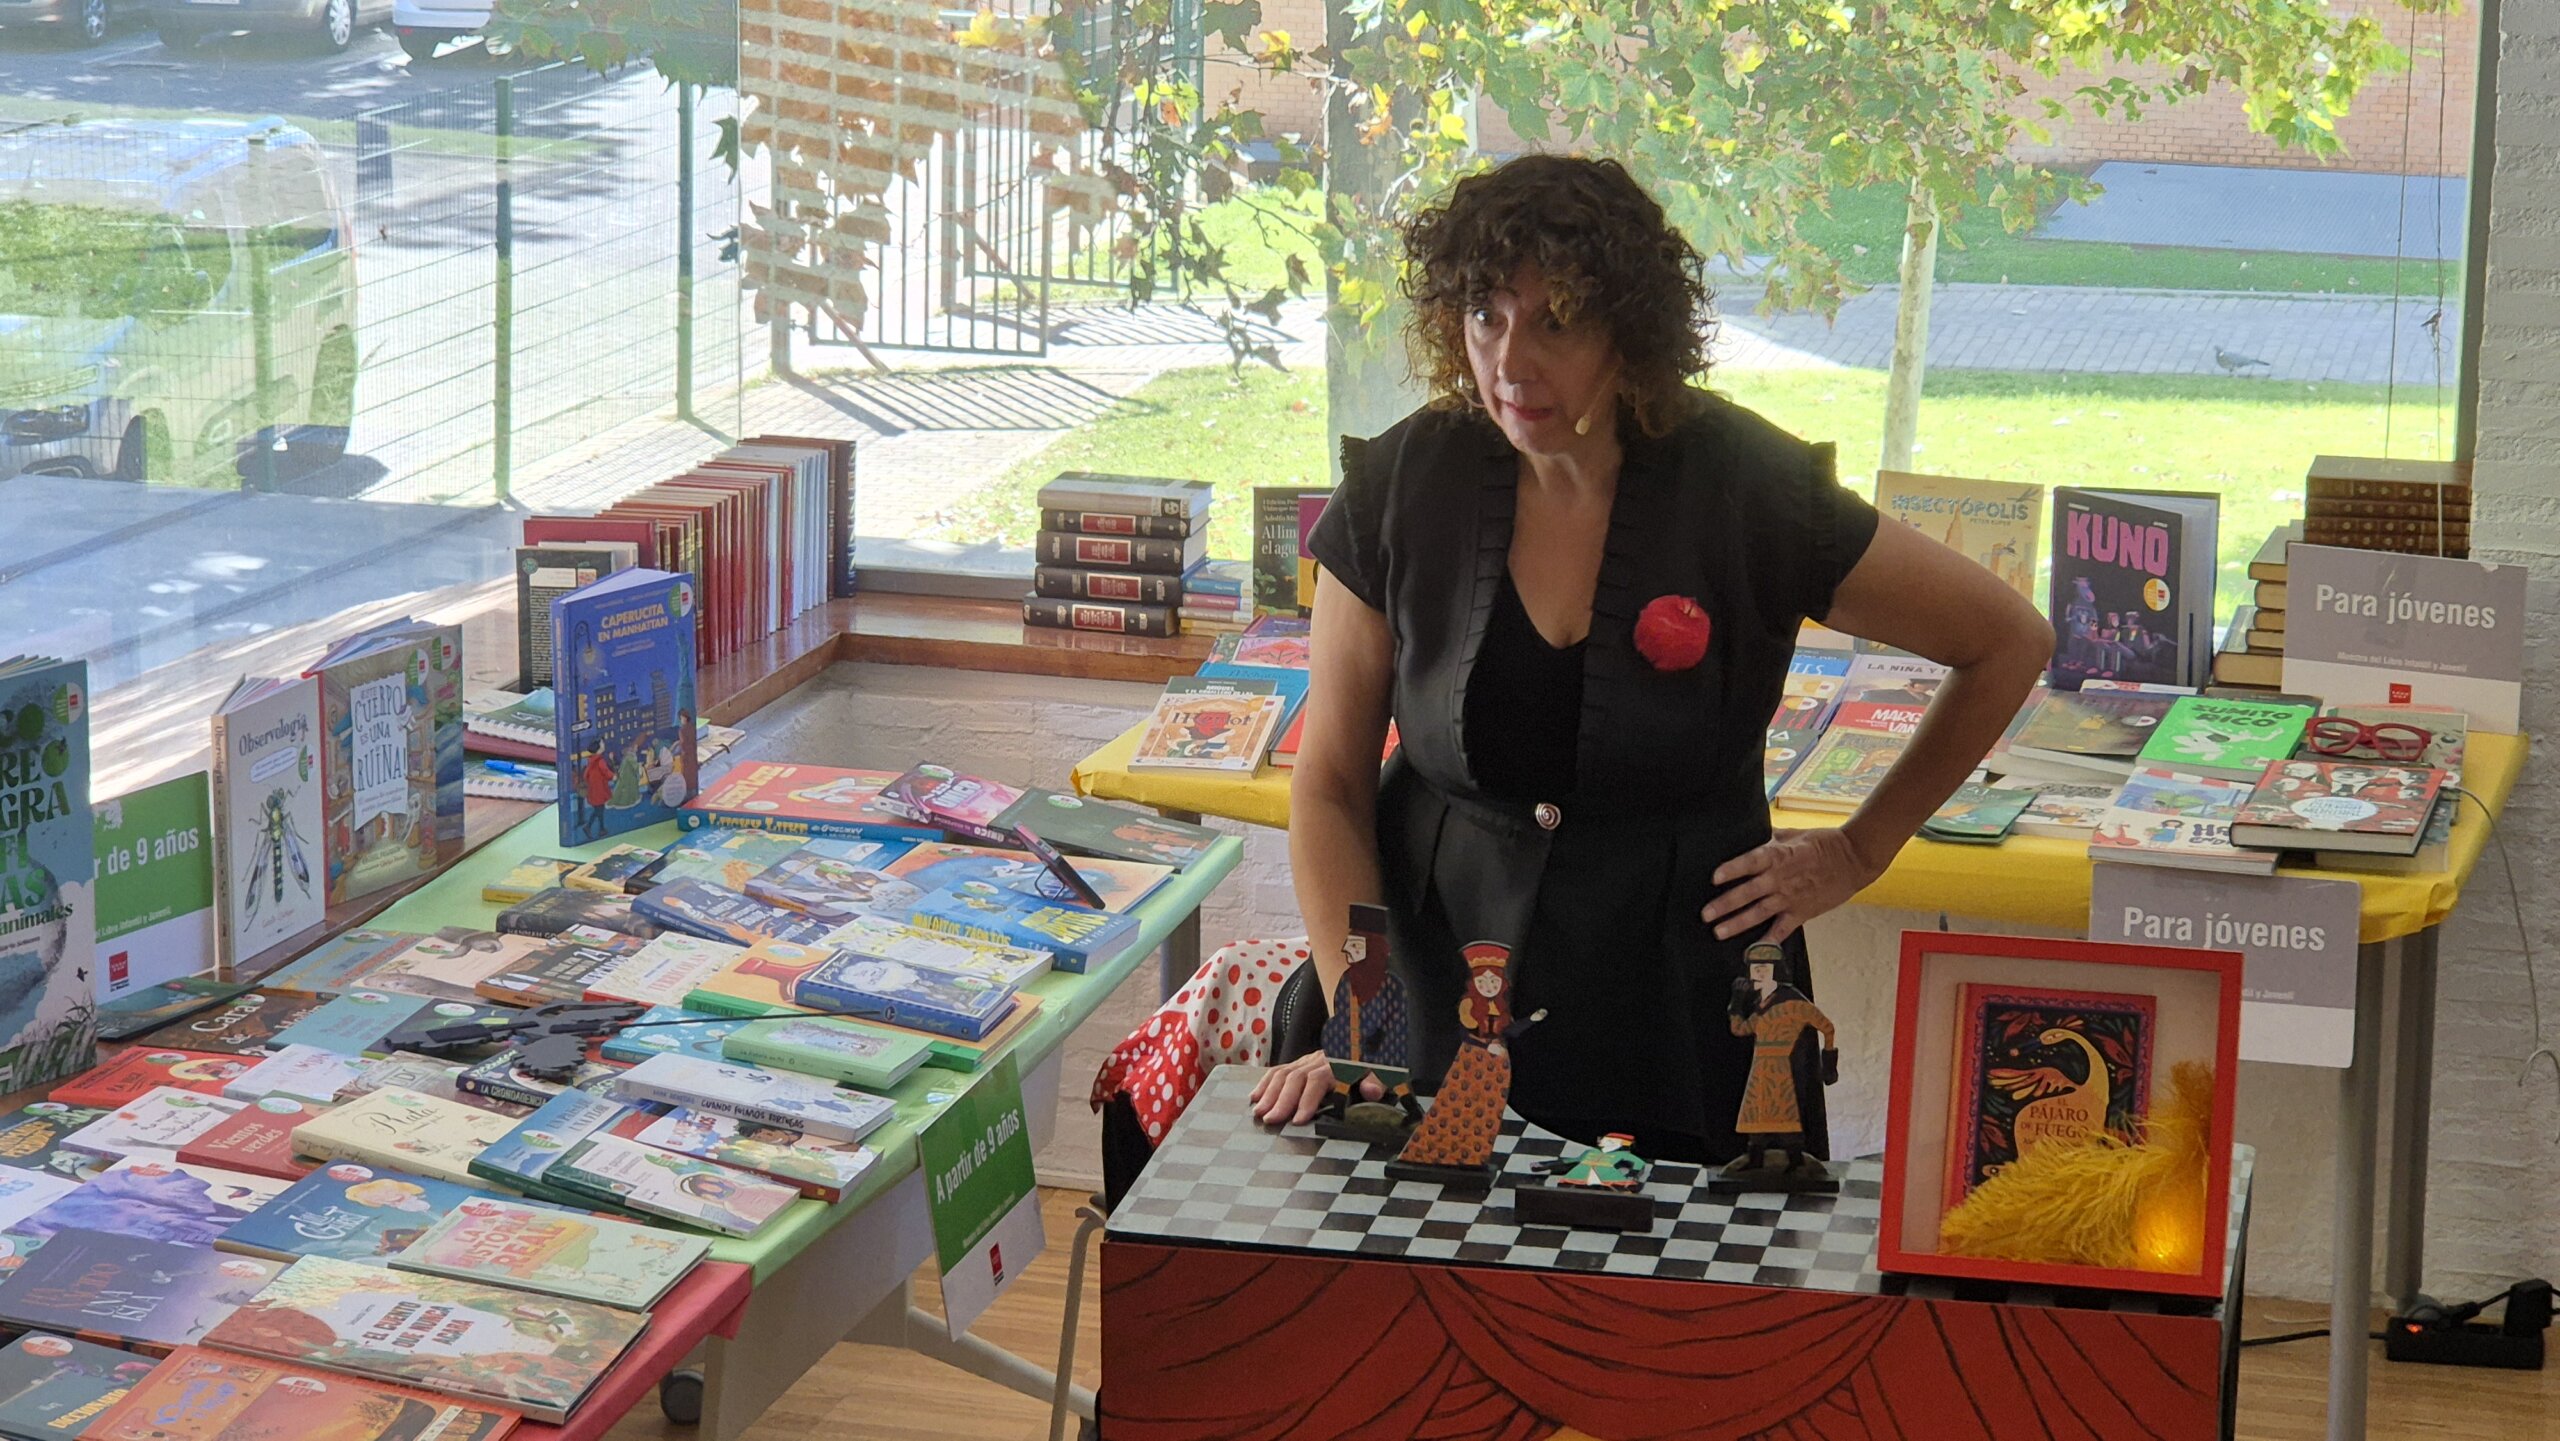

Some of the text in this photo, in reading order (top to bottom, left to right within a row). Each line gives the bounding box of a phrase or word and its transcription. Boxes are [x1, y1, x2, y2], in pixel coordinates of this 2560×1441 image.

[1274, 543, 1299, 558] agu
[2066, 510, 2169, 577] KUNO
[601, 603, 665, 629] CAPERUCITA
[2315, 583, 2497, 630] Para jóvenes
[612, 616, 670, 639] MANHATTAN
[354, 684, 404, 733] CUERPO
[1871, 708, 1925, 723] MARG
[2192, 704, 2293, 720] ZUMITO
[2195, 713, 2278, 728] RICO
[107, 846, 131, 876] de
[136, 837, 148, 866] 9
[154, 827, 200, 861] años
[0, 903, 74, 936] animales
[2122, 906, 2326, 951] Para jóvenes
[190, 1000, 262, 1034] Cara
[700, 1099, 732, 1113] CUANDO
[2030, 1103, 2089, 1123] PÁJARO
[2035, 1122, 2089, 1138] FUEGO
[935, 1108, 1021, 1205] A partir de 9 años
